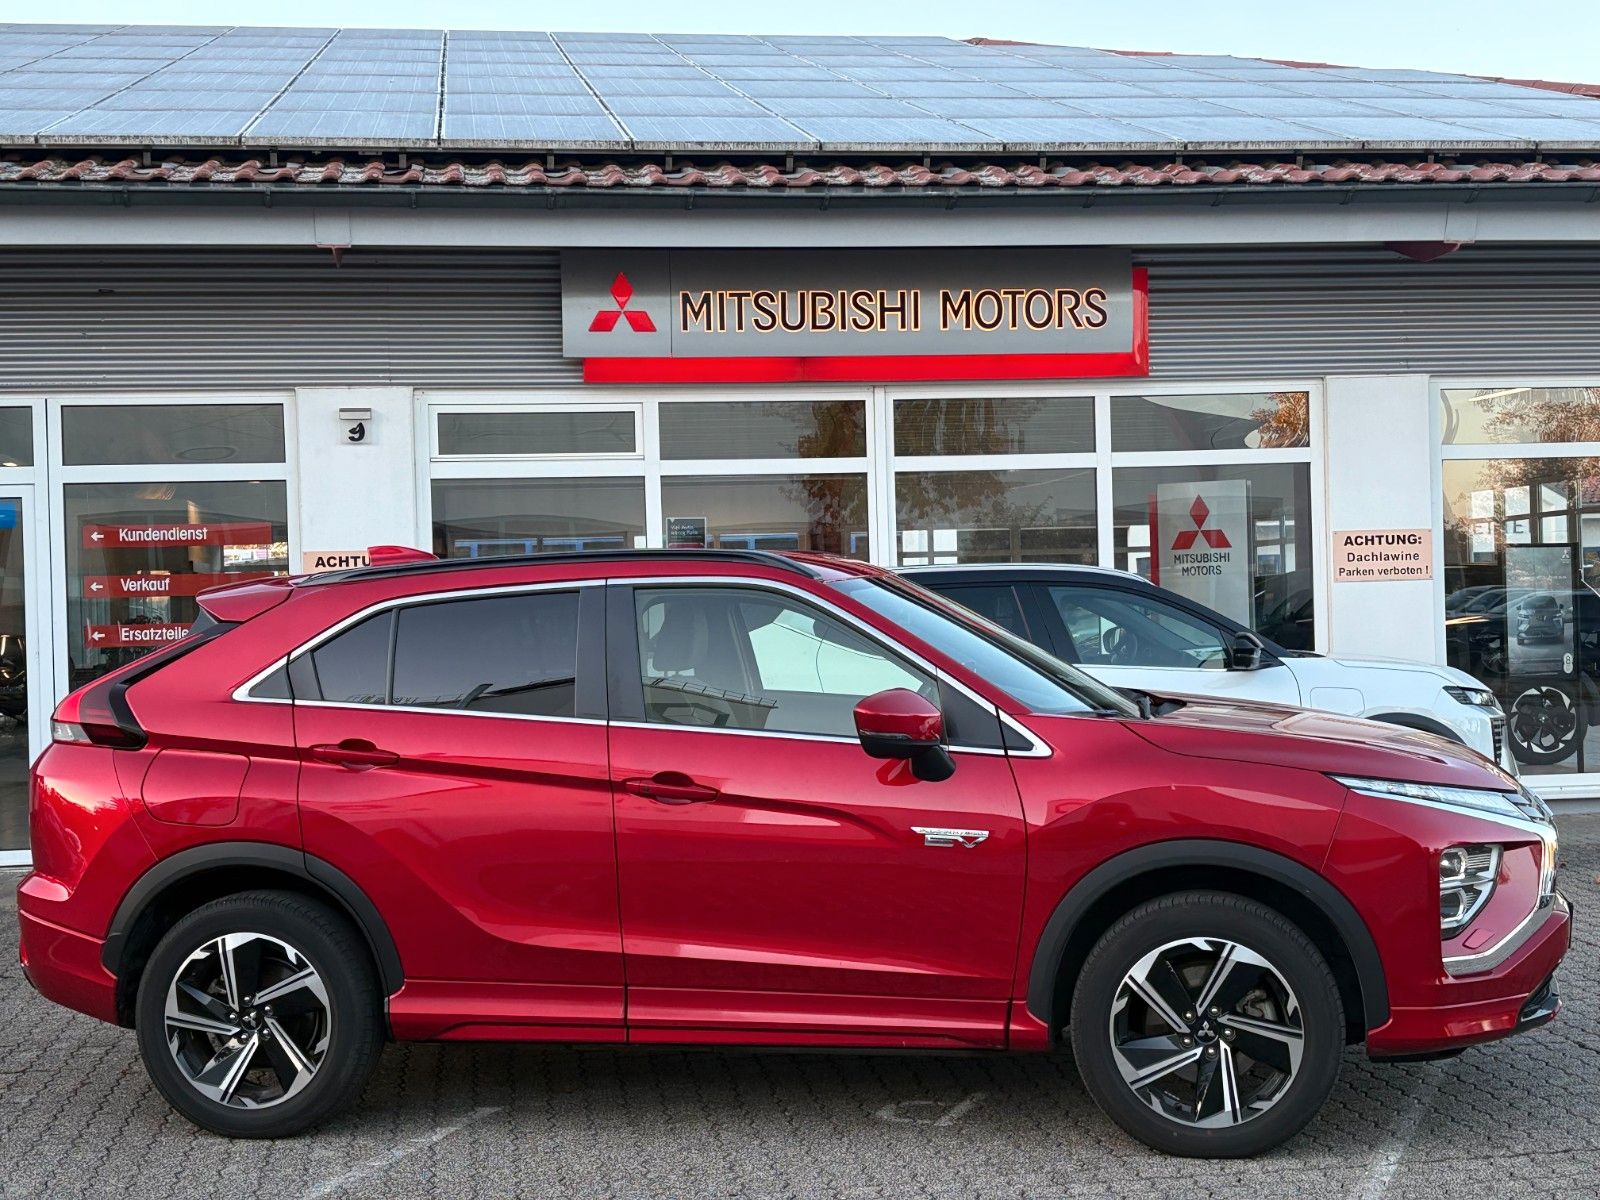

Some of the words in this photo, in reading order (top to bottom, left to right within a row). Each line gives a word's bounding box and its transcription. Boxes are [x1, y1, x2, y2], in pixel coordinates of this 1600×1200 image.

[680, 289, 921, 333] MITSUBISHI
[939, 287, 1108, 332] MOTORS
[119, 527, 208, 542] Kundendienst
[1343, 533, 1422, 547] ACHTUNG:
[1173, 551, 1231, 565] MITSUBISHI
[1347, 551, 1420, 562] Dachlawine
[1181, 564, 1222, 577] MOTORS
[1338, 567, 1375, 577] Parken
[1377, 566, 1422, 576] verboten
[120, 577, 170, 592] Verkauf
[121, 626, 190, 641] Ersatzteile
